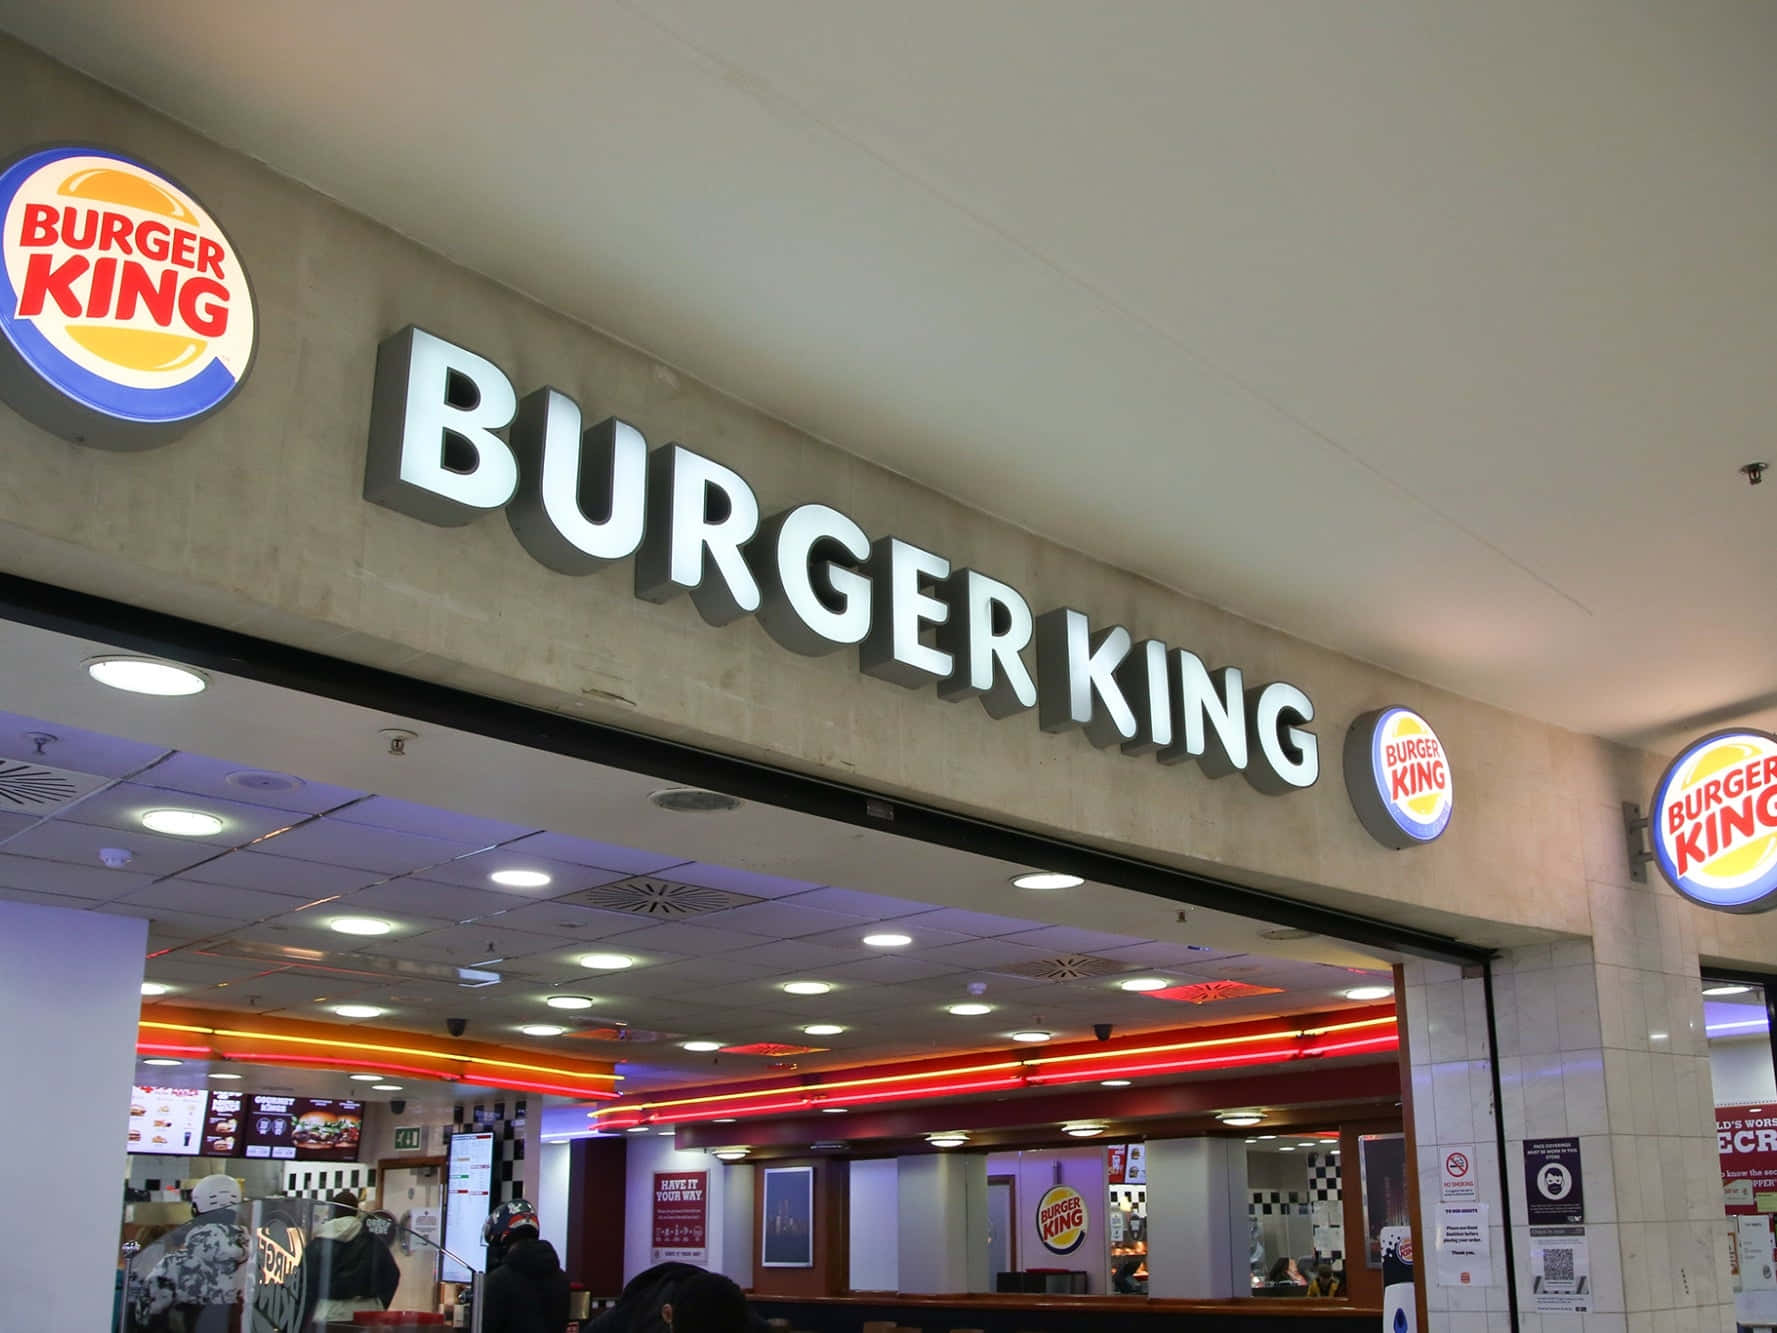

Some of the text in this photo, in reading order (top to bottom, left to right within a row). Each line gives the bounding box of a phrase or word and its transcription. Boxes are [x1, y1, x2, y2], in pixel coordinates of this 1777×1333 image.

[19, 203, 225, 280] BURGER
[18, 253, 230, 338] KING
[399, 326, 1320, 788] BURGER KING
[1385, 738, 1440, 767] BURGER
[1391, 760, 1445, 800] KING
[1668, 755, 1777, 834] BURGER
[1745, 1118, 1777, 1128] WORS
[1716, 1129, 1777, 1154] ECR
[656, 1190, 703, 1202] YOUR WAY
[661, 1179, 698, 1190] HAVE IT
[1041, 1196, 1081, 1224] BURGER
[1043, 1208, 1083, 1241] KING
